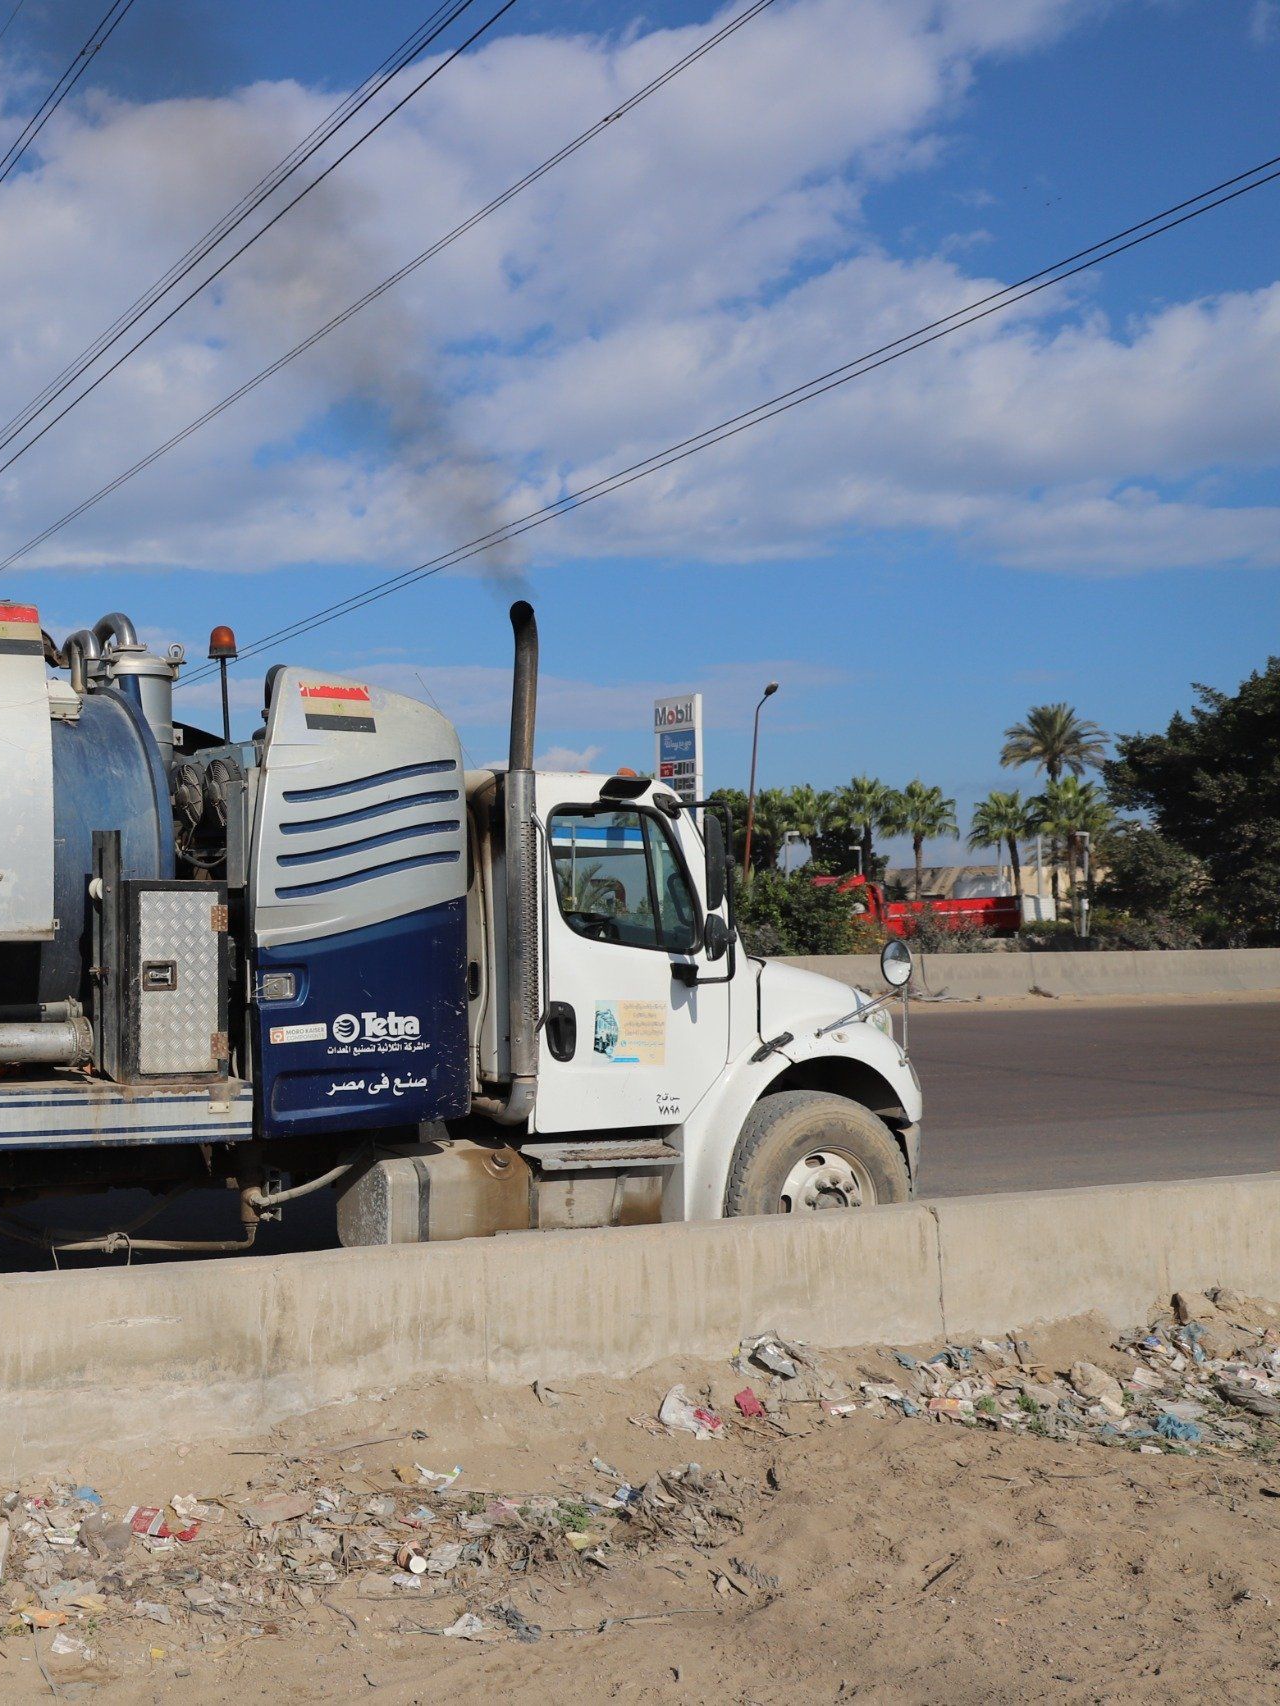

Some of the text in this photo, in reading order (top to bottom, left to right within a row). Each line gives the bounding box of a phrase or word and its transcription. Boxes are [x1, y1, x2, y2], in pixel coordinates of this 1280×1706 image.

[654, 702, 693, 727] Mobil
[361, 1011, 420, 1037] Tetra
[286, 1028, 304, 1036] MORO
[327, 1045, 351, 1055] المعدات
[353, 1044, 375, 1056] لتصنيع
[377, 1042, 402, 1054] الثلاثية
[325, 1079, 365, 1096] مصر
[393, 1071, 428, 1096] صنع
[658, 1105, 680, 1116] ٧٨٩٨
